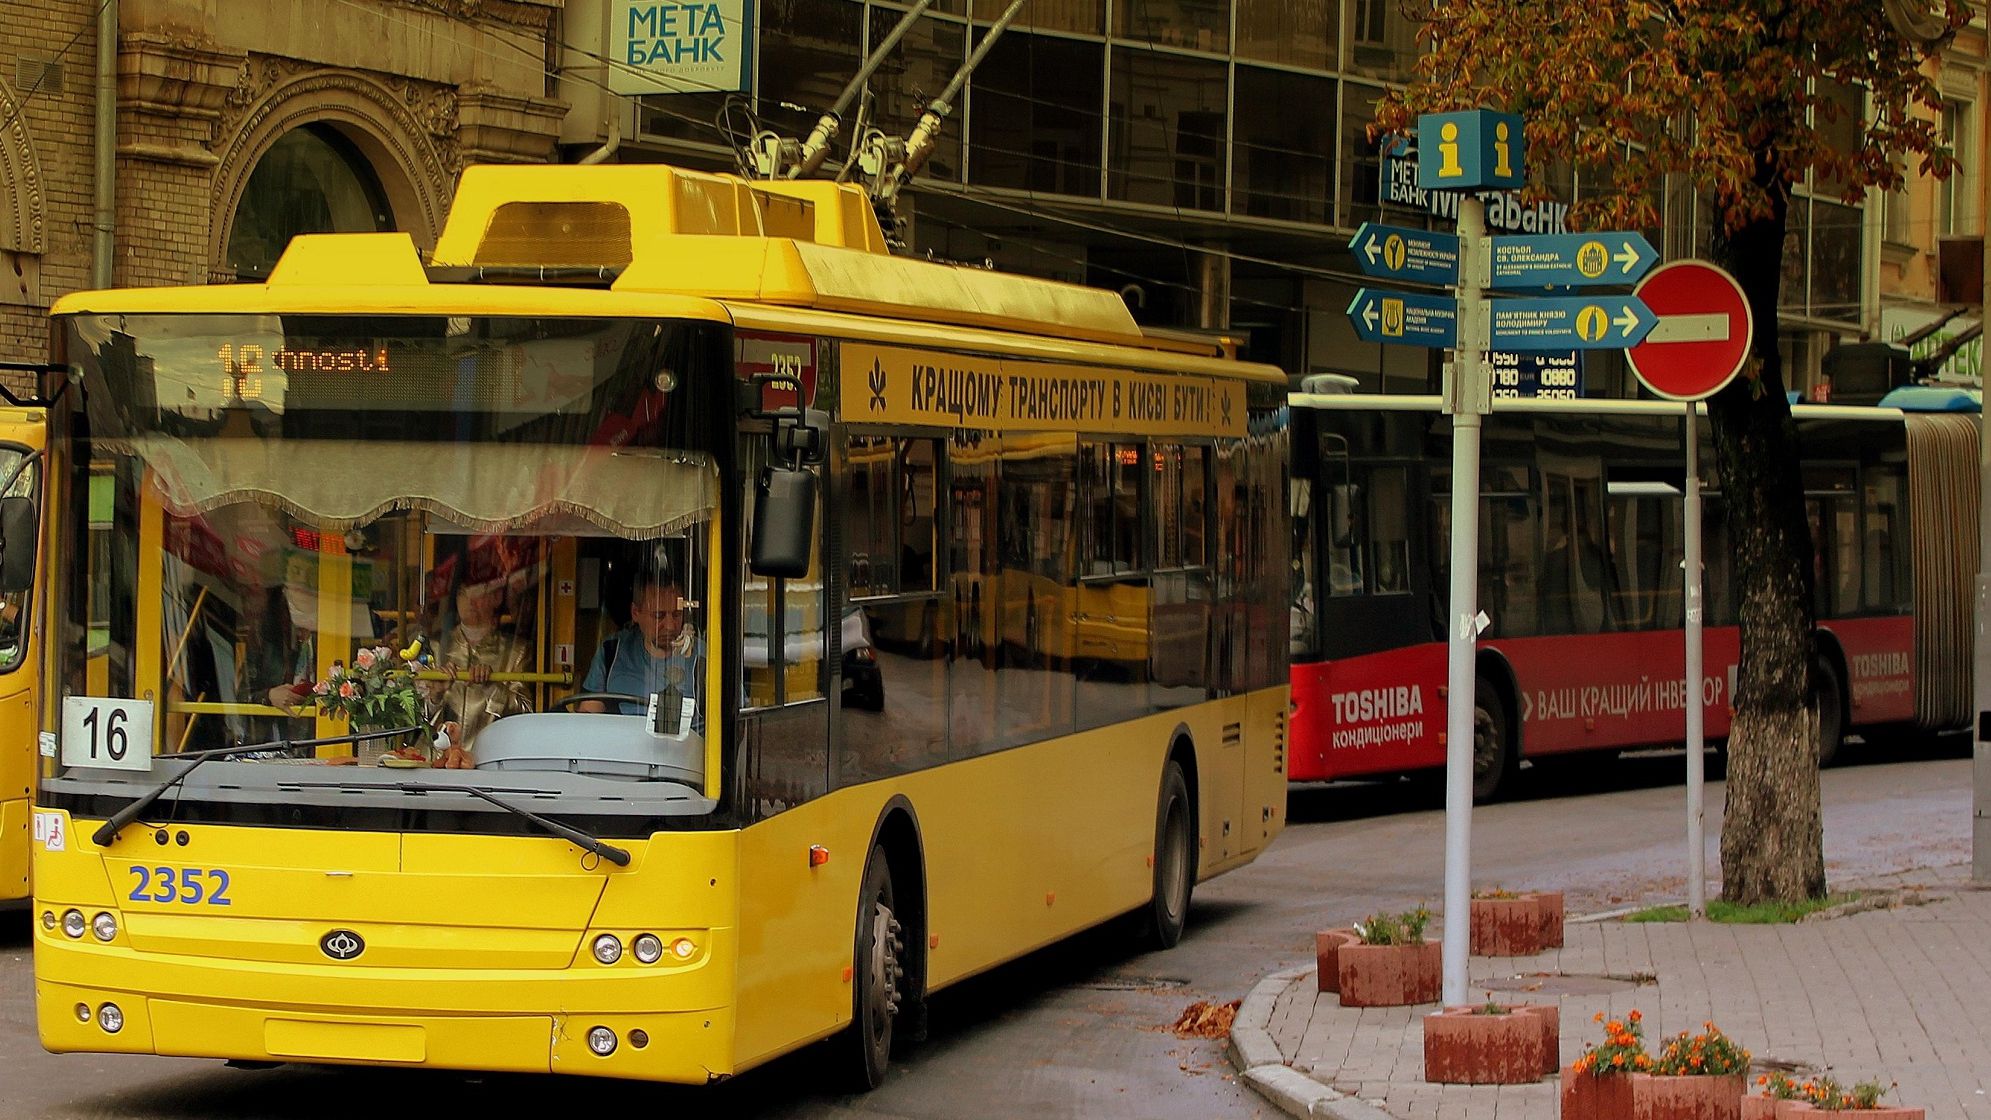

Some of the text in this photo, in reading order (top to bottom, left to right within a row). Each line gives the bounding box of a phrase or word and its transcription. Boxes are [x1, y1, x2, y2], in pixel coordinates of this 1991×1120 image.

[628, 3, 726, 38] МЕТА
[627, 36, 725, 65] БАНК
[1390, 158, 1420, 187] МЕТ
[1390, 182, 1428, 208] БАНК
[1496, 245, 1531, 255] КОСТЬОЛ
[1510, 252, 1560, 262] ОЛЕКСАНДРА
[1495, 319, 1548, 329] ВОЛОДИМИРУ
[1539, 309, 1566, 319] КНЯЗЮ
[1540, 368, 1576, 387] 10880
[911, 363, 1001, 425] КРАЩОМУ
[1009, 375, 1106, 421] ТРАНСПОРТУ
[1112, 380, 1121, 418] В
[1128, 381, 1167, 421] КИЄВІ
[1852, 652, 1909, 678] TOSHIBA
[1331, 684, 1423, 725] TOSHIBA
[1537, 675, 1723, 721] ВАШ КРАЩИЙ ІНВЕОР
[83, 706, 128, 761] 16
[1332, 718, 1423, 750] кондиціонери
[128, 865, 232, 906] 2352
